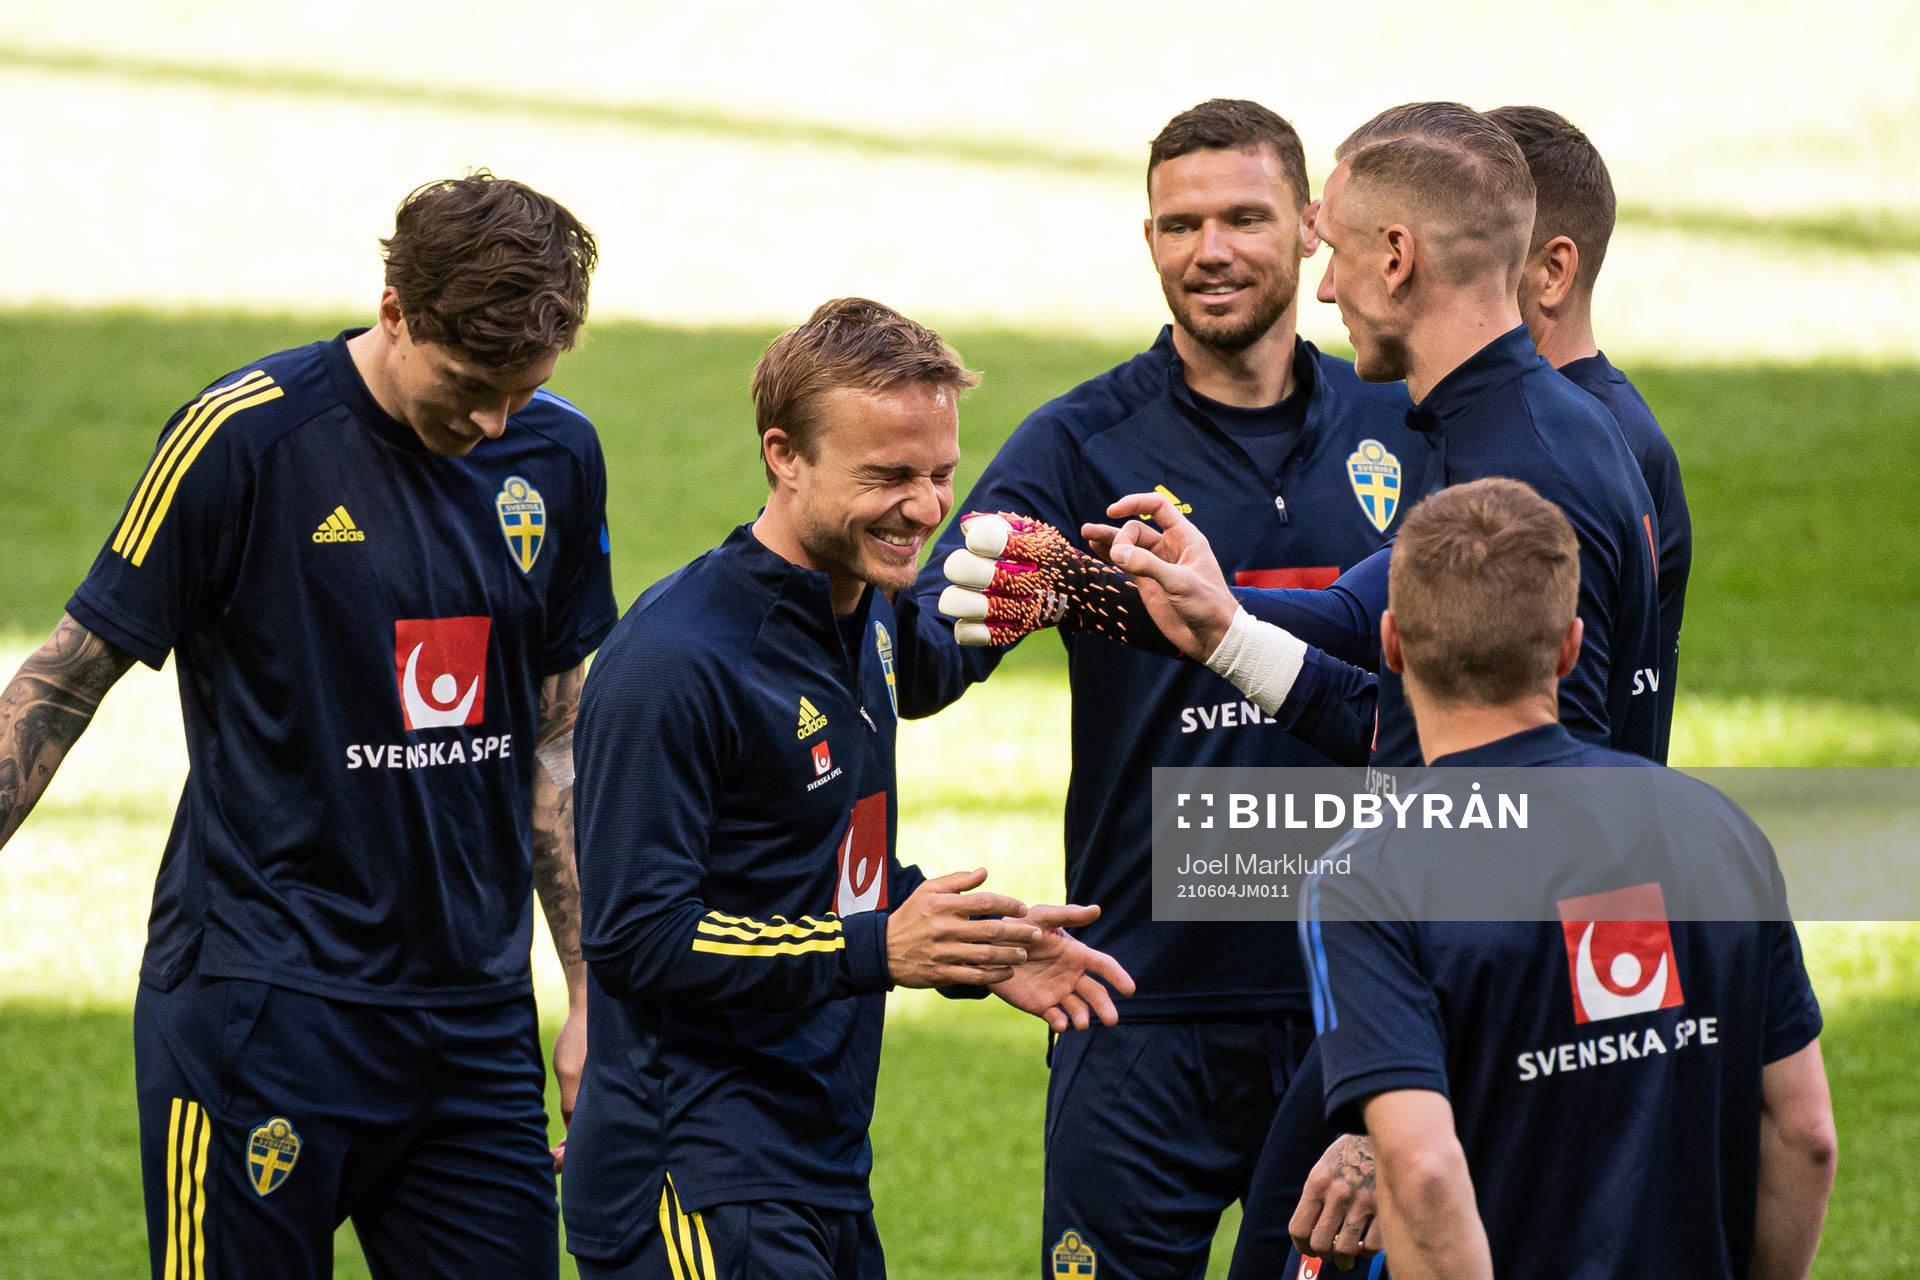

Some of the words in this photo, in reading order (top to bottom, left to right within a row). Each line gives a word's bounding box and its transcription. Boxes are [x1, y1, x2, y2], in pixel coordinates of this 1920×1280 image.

[312, 528, 365, 543] adidas
[797, 714, 828, 740] adidas
[1181, 702, 1278, 734] SVEN
[346, 740, 467, 770] SVENSKA
[807, 774, 831, 792] SVENSKA
[830, 767, 843, 780] SPEL
[1517, 1028, 1668, 1081] SVENSKA
